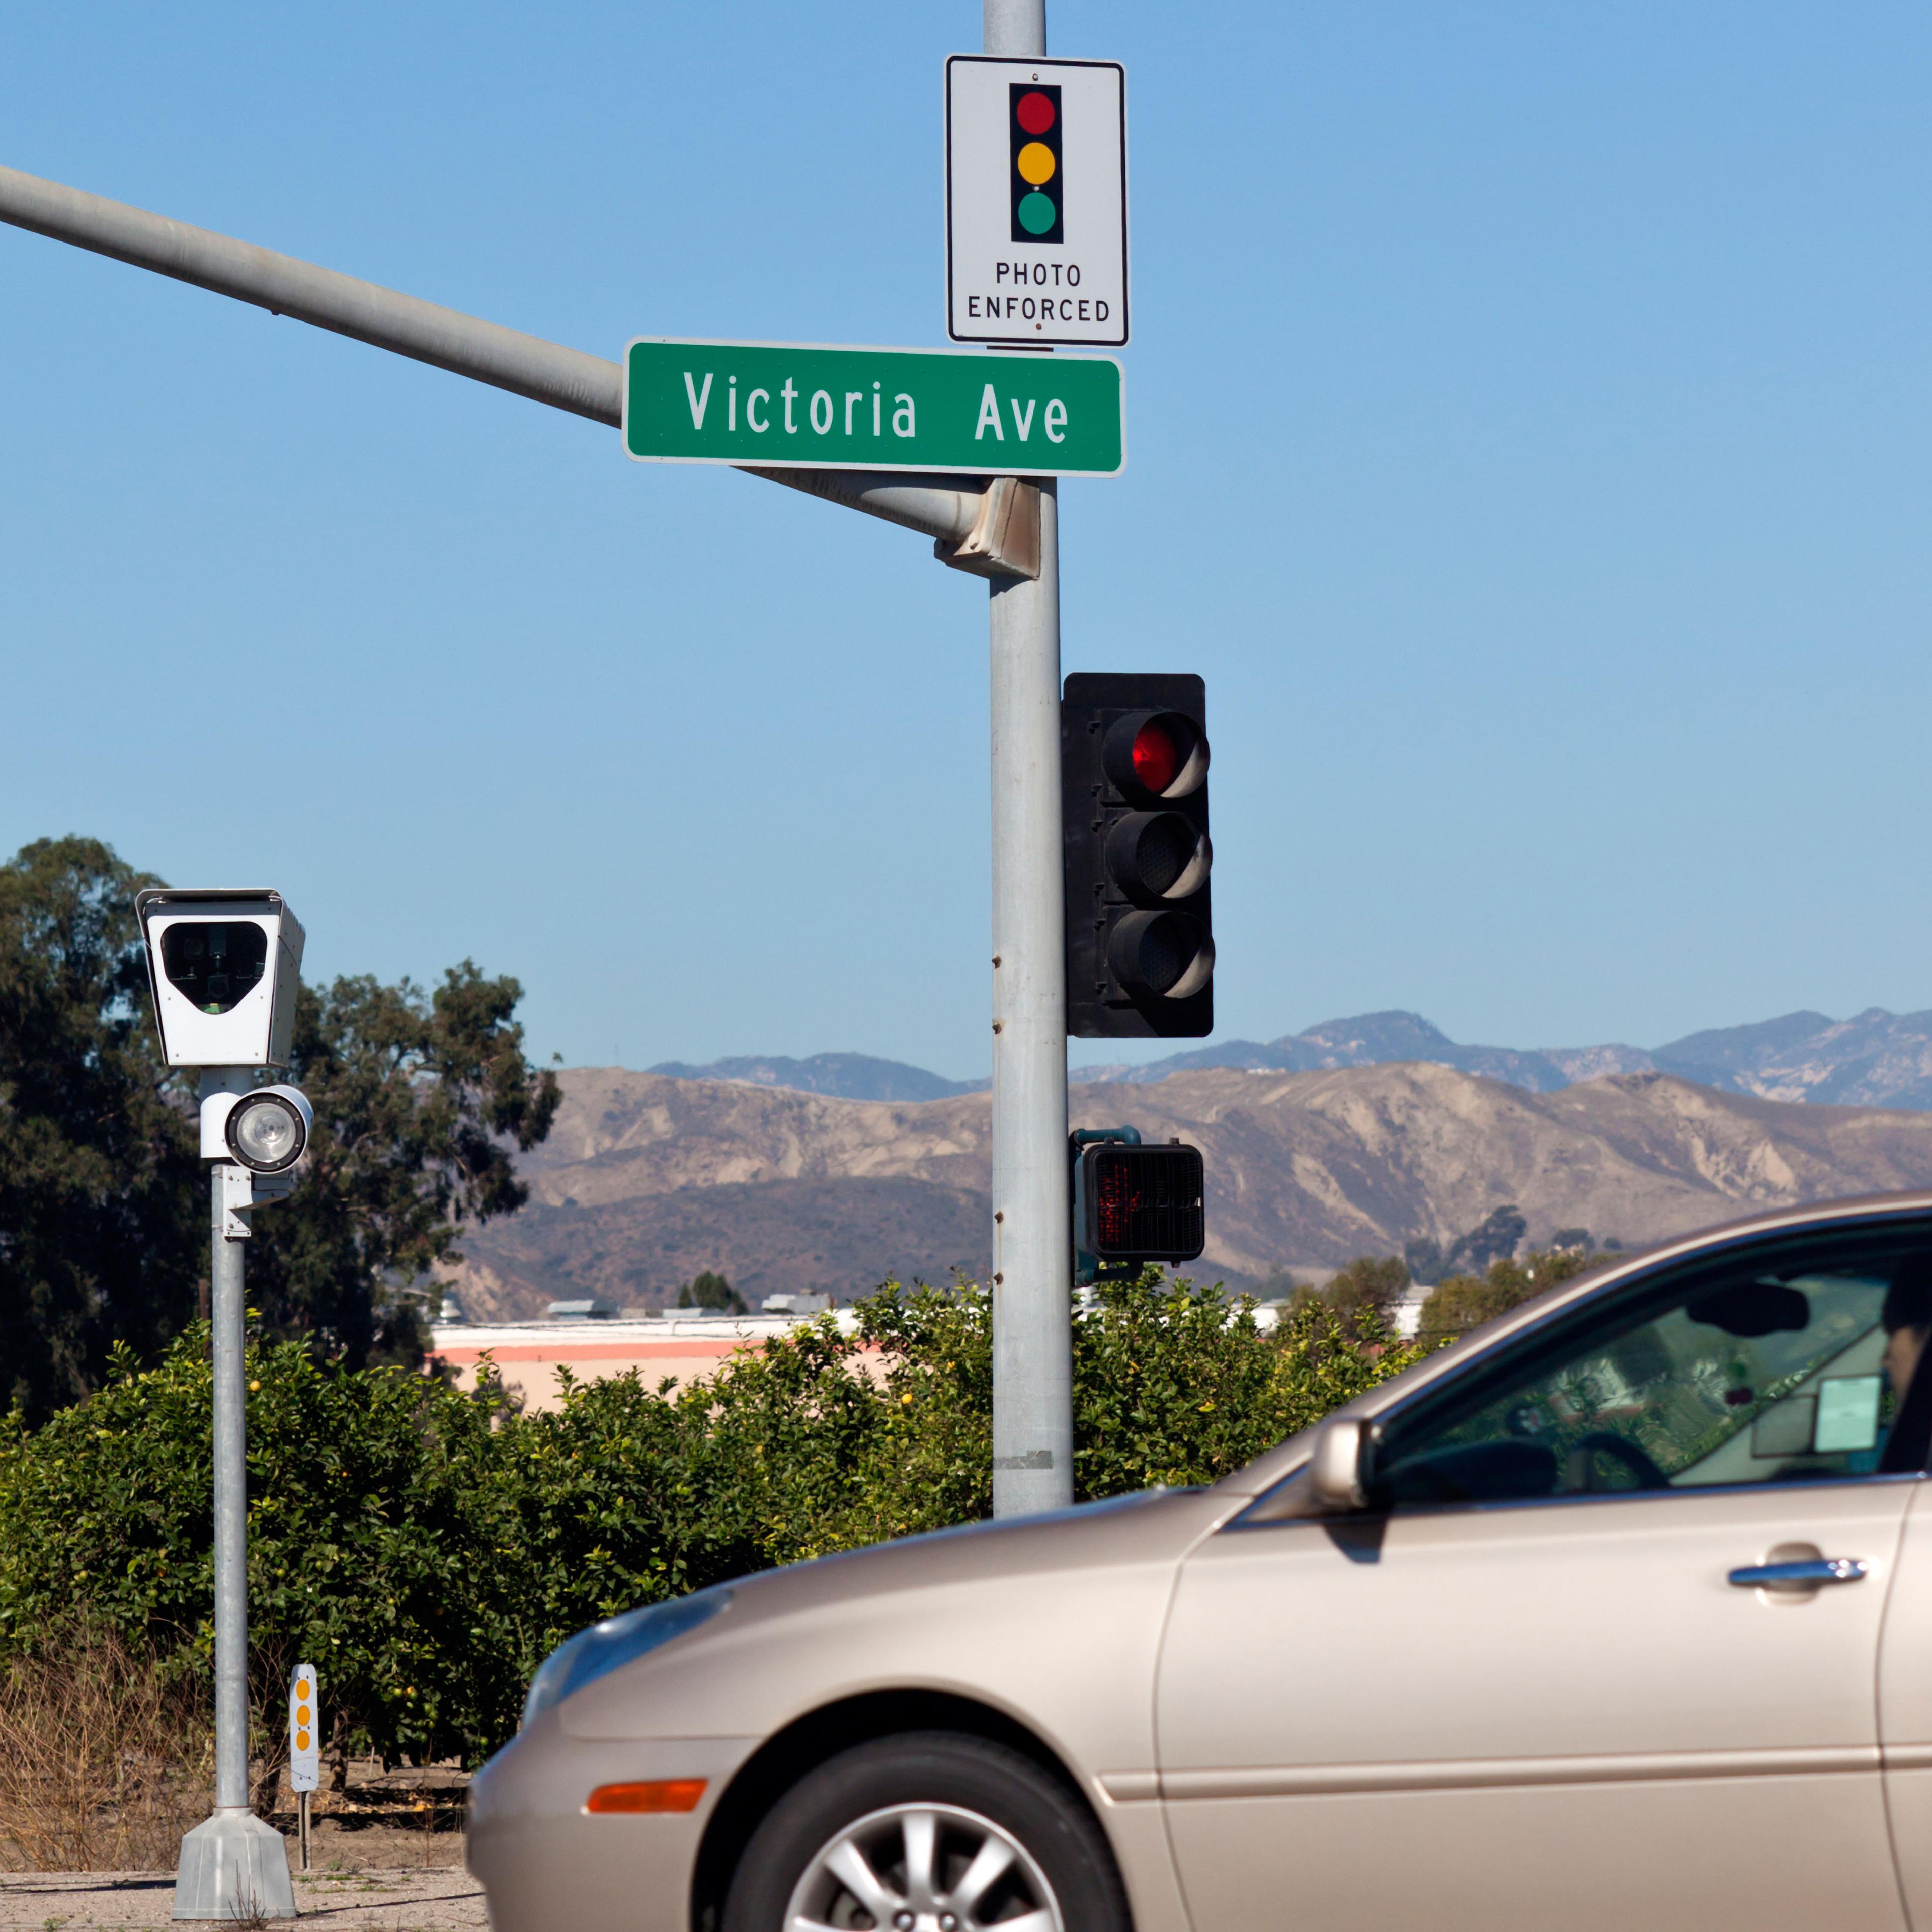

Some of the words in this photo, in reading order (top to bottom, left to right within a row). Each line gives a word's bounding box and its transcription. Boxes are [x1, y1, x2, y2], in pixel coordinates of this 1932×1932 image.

[996, 262, 1080, 287] PHOTO
[969, 296, 1109, 321] ENFORCED
[684, 372, 916, 437] Victoria
[975, 384, 1068, 443] Ave
